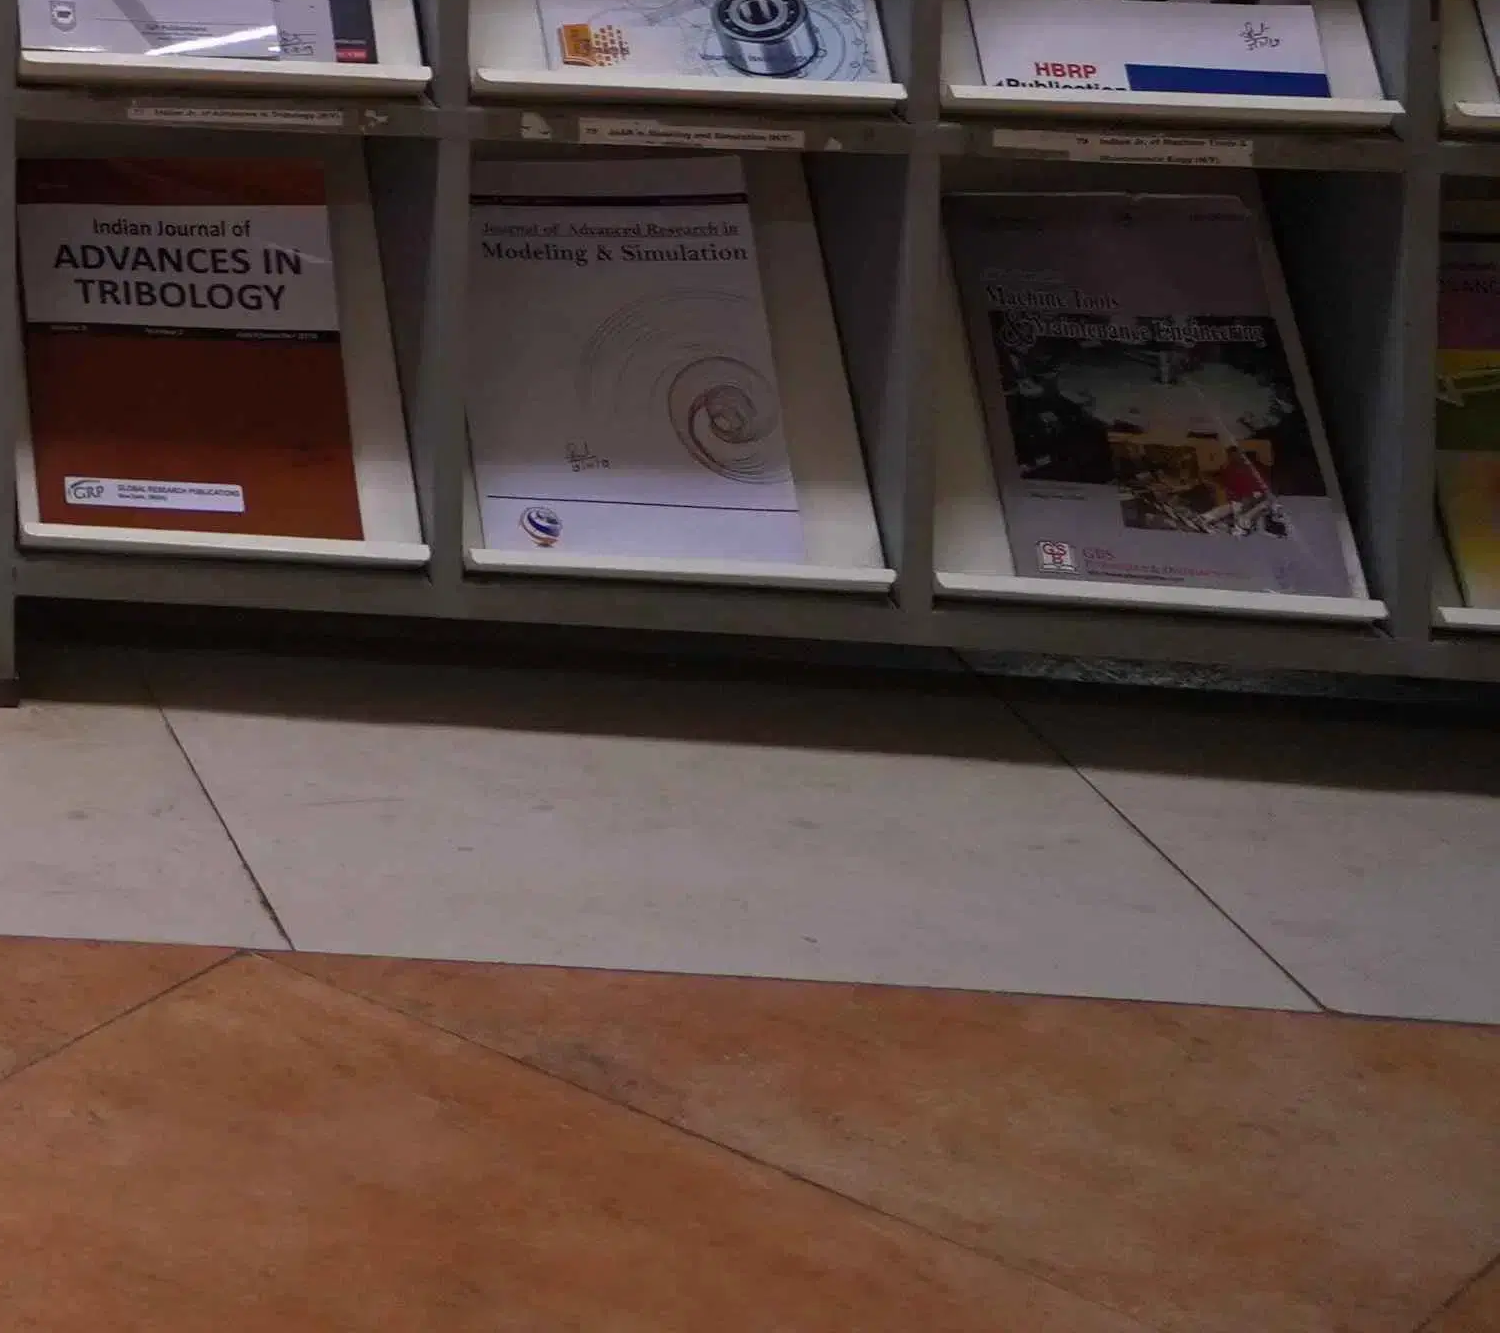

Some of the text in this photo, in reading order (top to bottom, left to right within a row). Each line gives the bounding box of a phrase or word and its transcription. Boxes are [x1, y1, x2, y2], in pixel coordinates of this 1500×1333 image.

[1032, 62, 1098, 79] HBRP
[92, 217, 252, 239] Indian Journal of
[53, 243, 303, 276] ADVANCES IN
[480, 240, 749, 267] Modeling & Simulation
[73, 278, 287, 312] TRIBOLOGY
